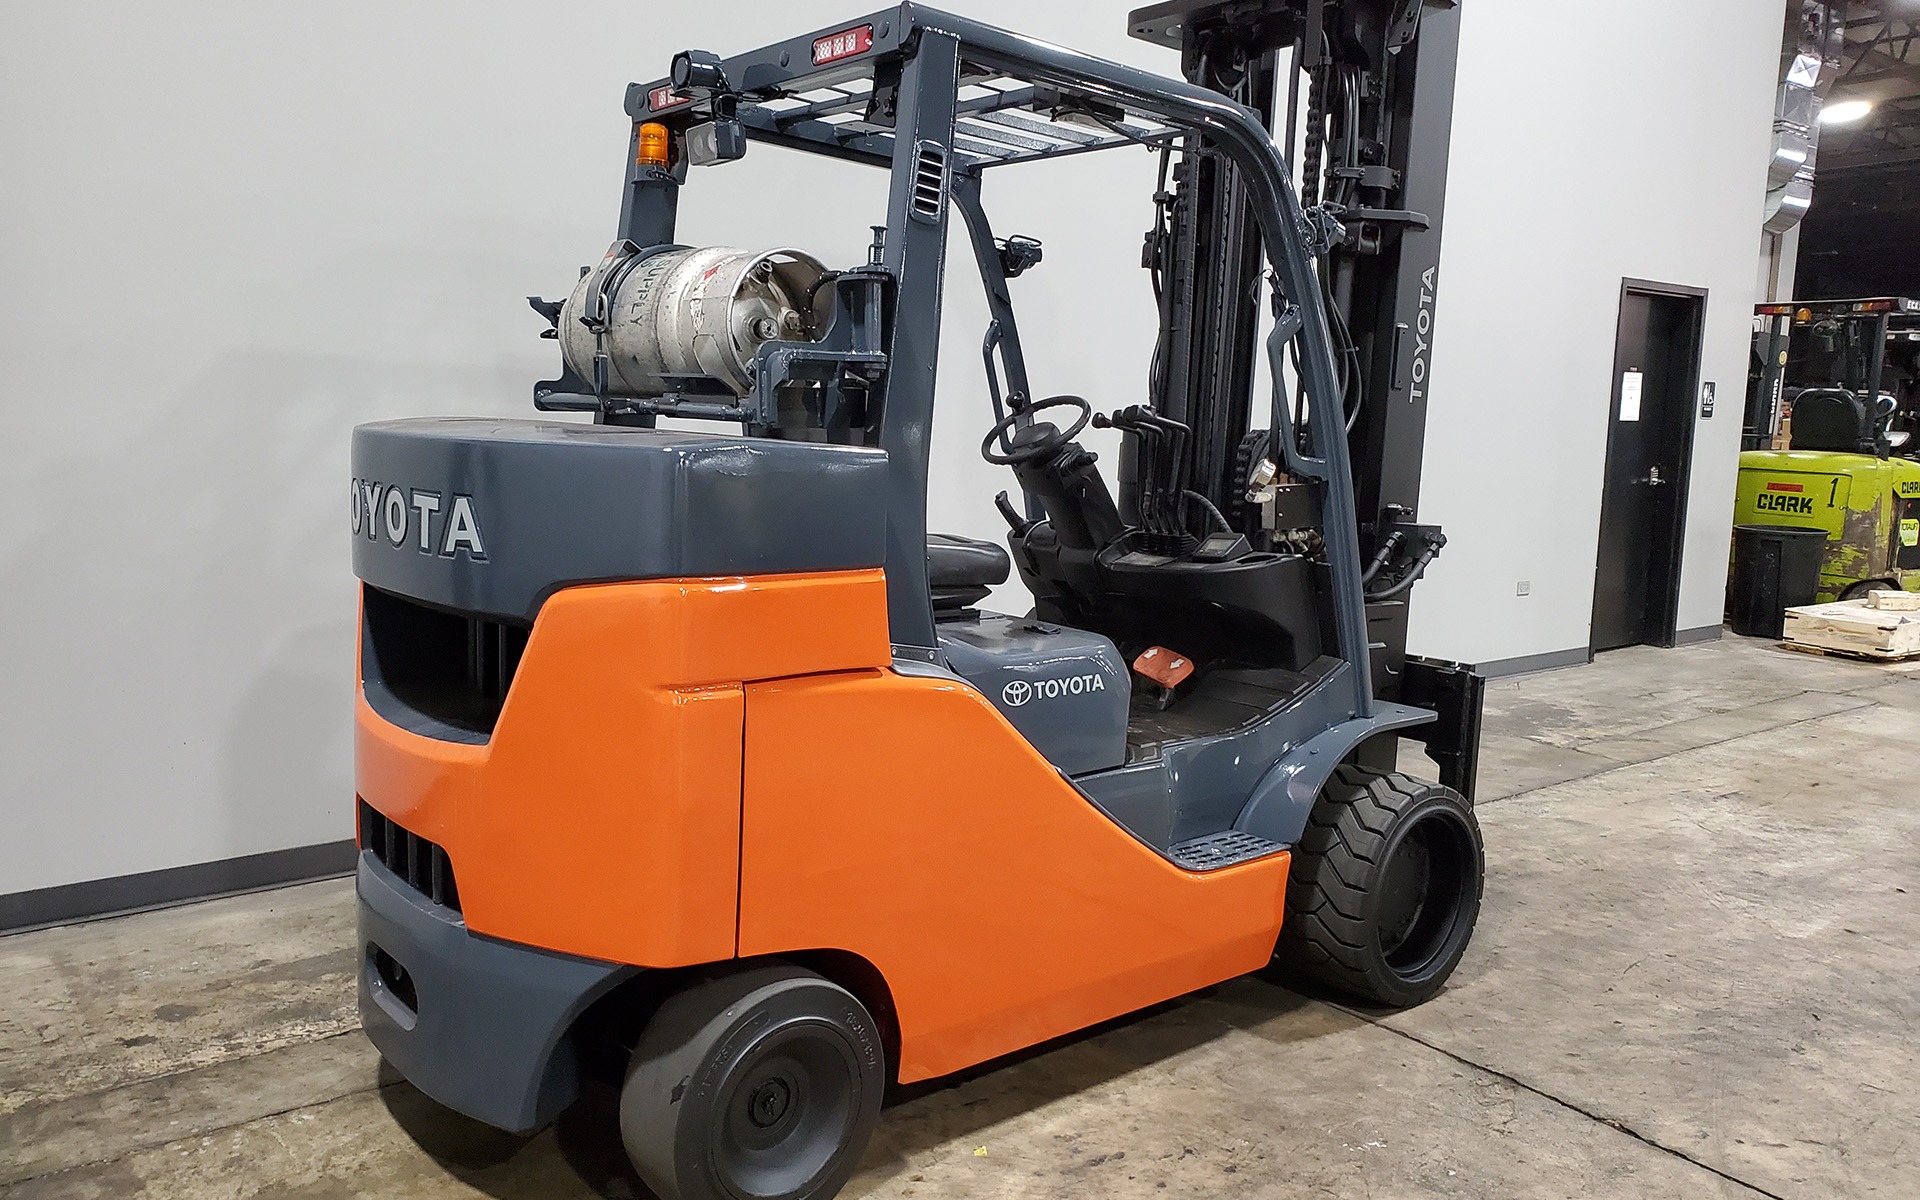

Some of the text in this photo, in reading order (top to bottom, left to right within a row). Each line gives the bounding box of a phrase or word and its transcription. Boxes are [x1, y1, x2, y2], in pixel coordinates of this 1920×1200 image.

[1409, 266, 1436, 404] TOYOTA
[1826, 477, 1840, 508] 1
[1901, 481, 1920, 494] CLAR
[1756, 493, 1814, 514] CLARK
[351, 477, 487, 560] OYOTA
[1033, 673, 1105, 699] TOYOTA
